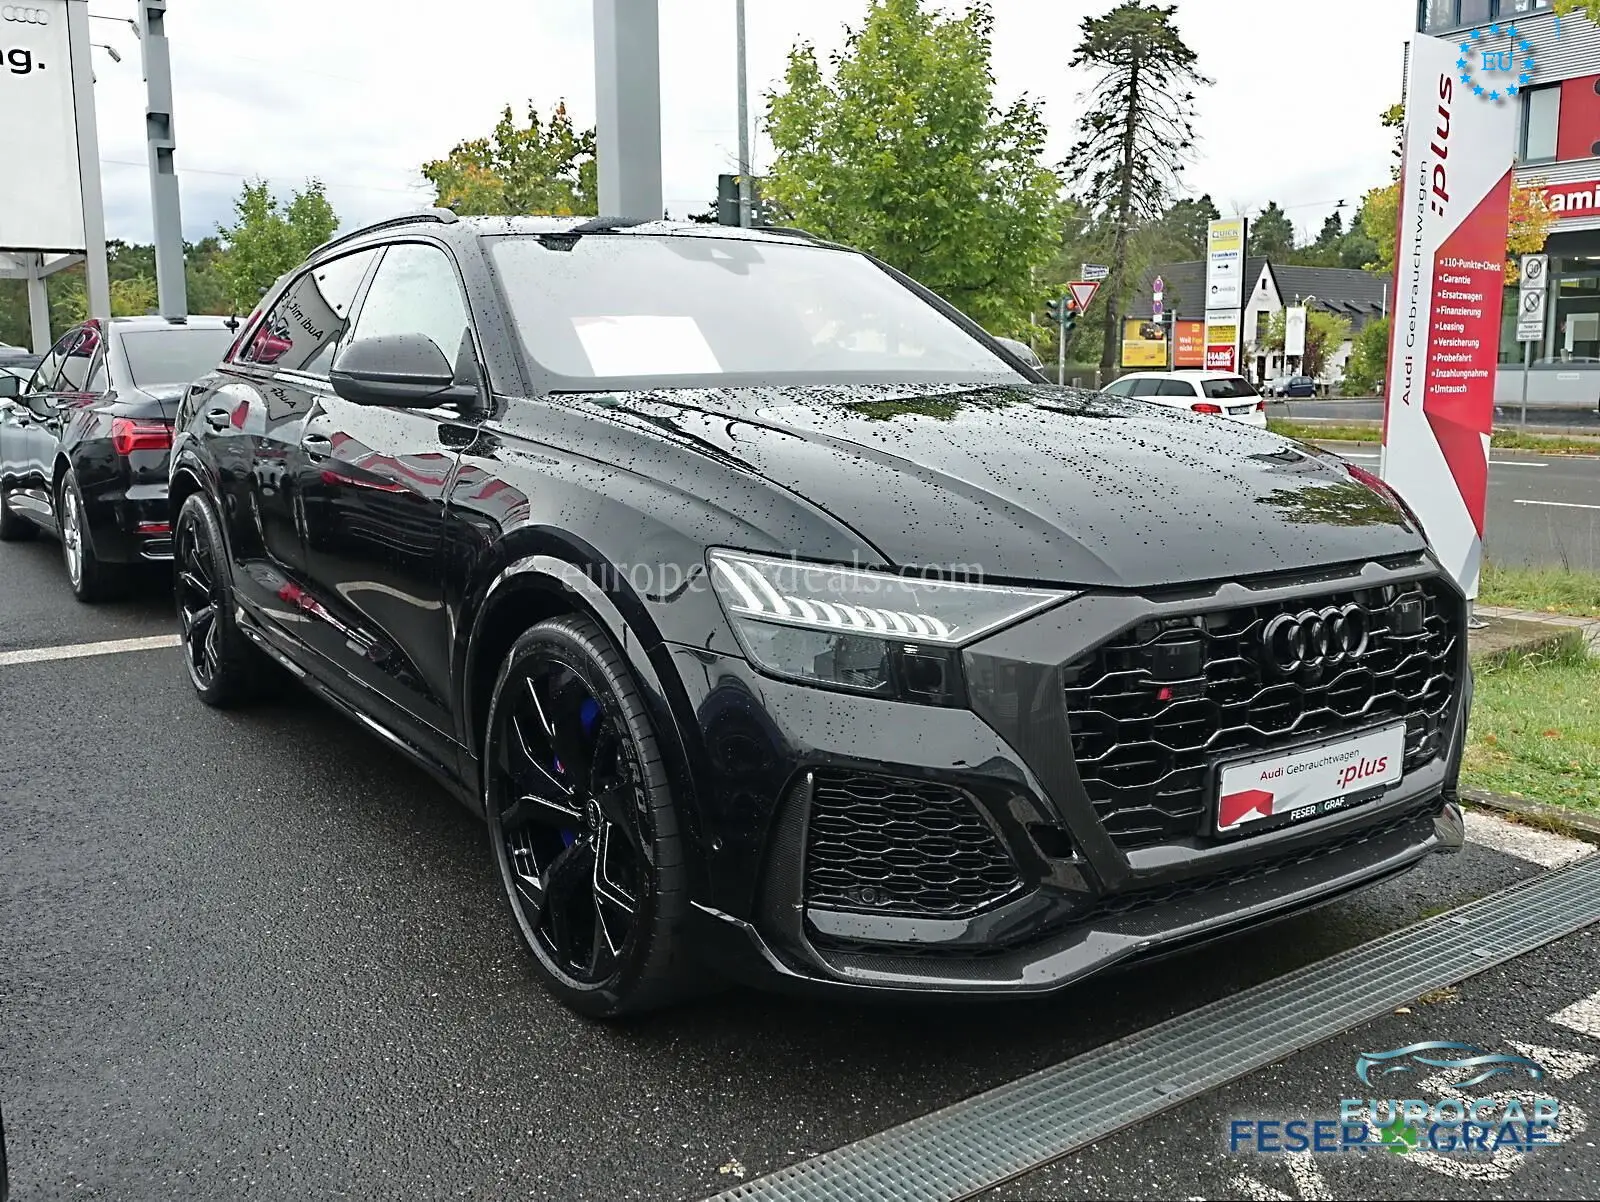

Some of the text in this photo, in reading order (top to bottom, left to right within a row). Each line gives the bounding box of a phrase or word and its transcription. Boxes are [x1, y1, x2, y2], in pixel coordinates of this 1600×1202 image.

[0, 48, 46, 75] g.
[1430, 72, 1453, 218] :plus
[1444, 256, 1501, 272] 110-Punkte-Check
[1529, 264, 1539, 274] 30
[1402, 160, 1428, 406] Audi Gebrauchtwagen
[1443, 273, 1471, 285] Garantie
[1442, 290, 1483, 302] Ersatzwagen
[1440, 306, 1482, 318] Finanzierung
[1439, 321, 1465, 333] Leasing
[1438, 337, 1480, 349] Versicherung
[1207, 351, 1231, 361] HARK
[1437, 352, 1472, 363] Probefahrt
[1435, 368, 1489, 379] Inzahlungnahme
[1434, 383, 1467, 394] Umtausch
[1260, 748, 1360, 781] Audi Gebrauchtwagen
[1337, 755, 1388, 789] :plus
[1290, 796, 1345, 820] FESER GRAF
